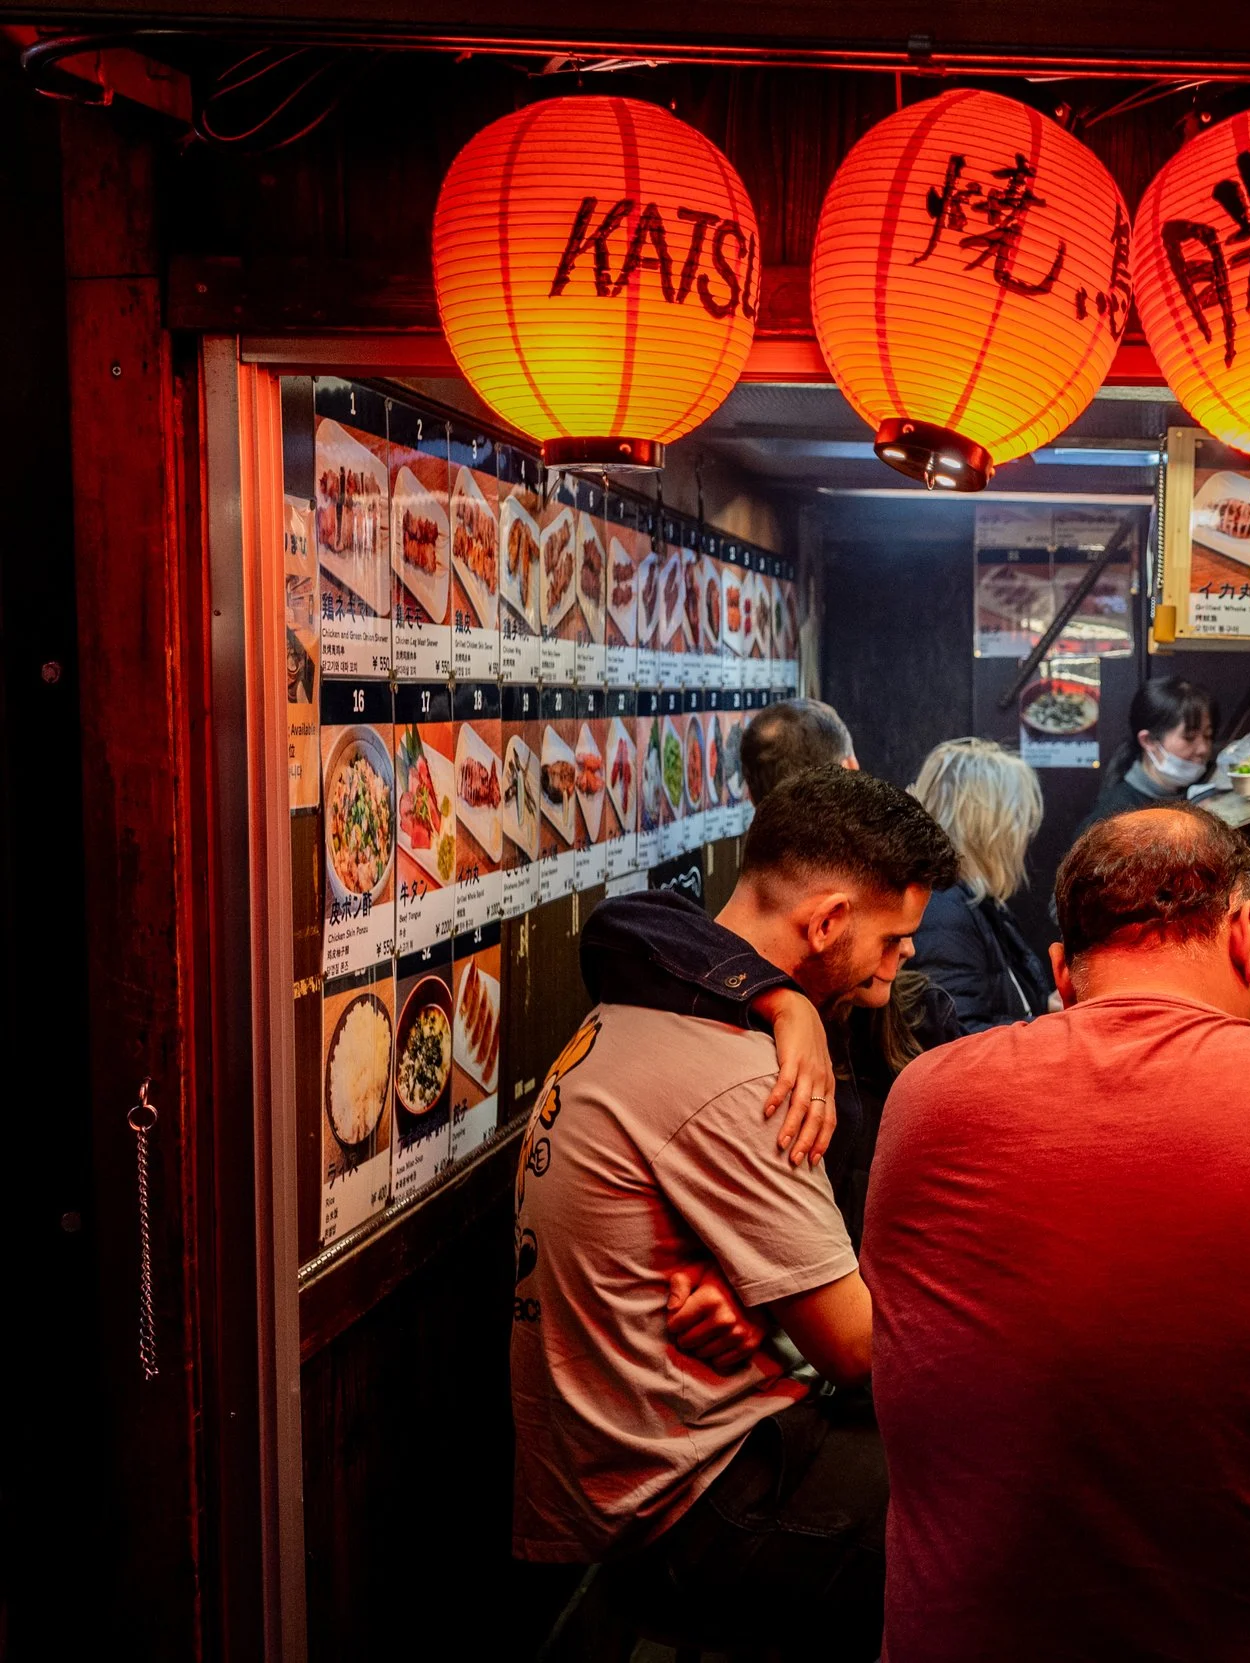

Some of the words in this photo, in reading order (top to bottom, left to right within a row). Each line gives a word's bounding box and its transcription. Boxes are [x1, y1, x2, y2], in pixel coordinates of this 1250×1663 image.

[350, 391, 356, 416] 1
[417, 418, 423, 441] 2
[472, 439, 478, 460] 3
[1195, 604, 1221, 612] Grilled
[321, 628, 340, 639] Chicken
[380, 656, 390, 671] 550
[352, 689, 365, 713] 16
[421, 690, 431, 712] 17
[474, 690, 482, 711] 18
[400, 880, 428, 907] 牛タン
[328, 932, 346, 944] Chicken
